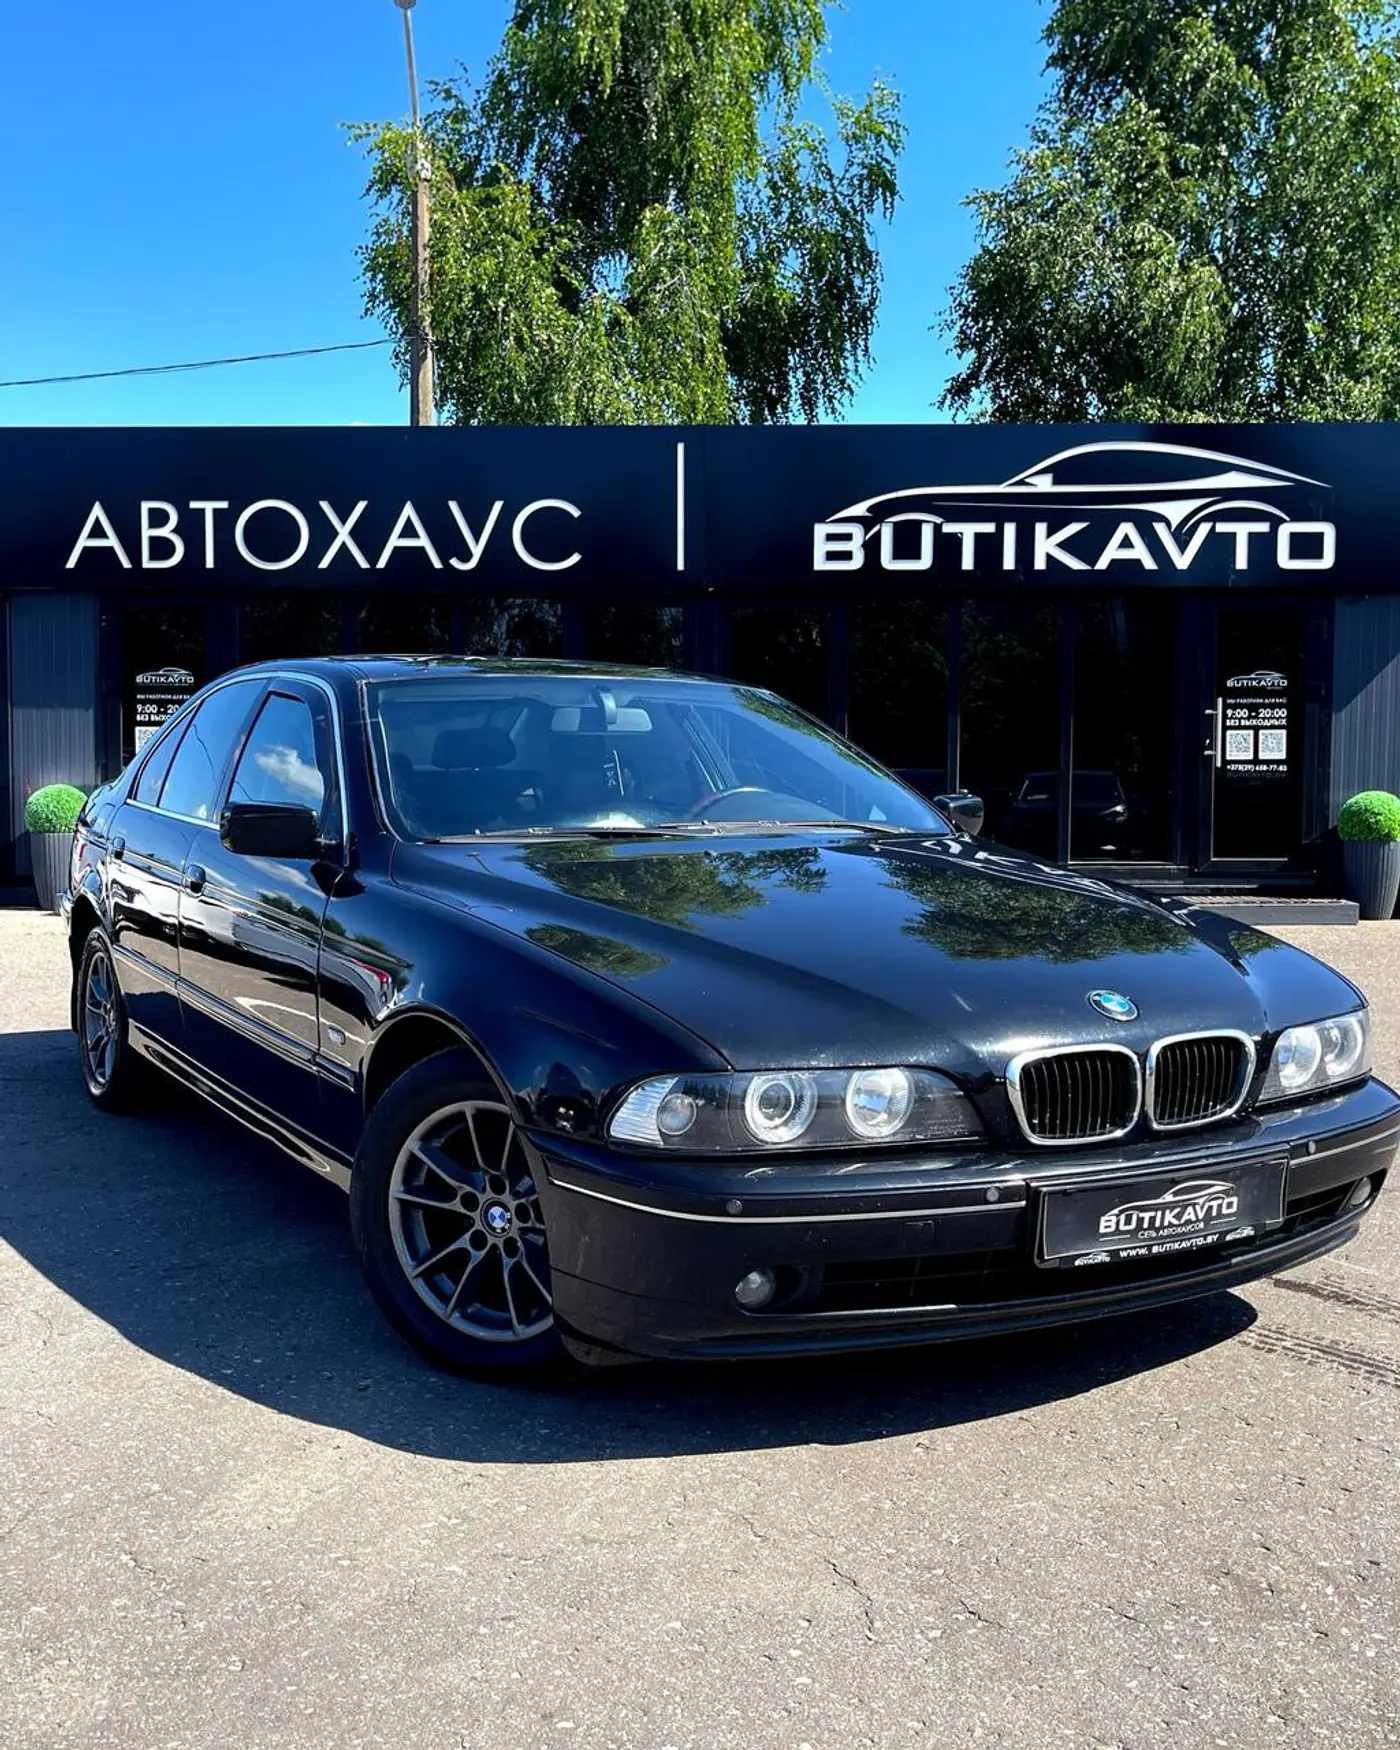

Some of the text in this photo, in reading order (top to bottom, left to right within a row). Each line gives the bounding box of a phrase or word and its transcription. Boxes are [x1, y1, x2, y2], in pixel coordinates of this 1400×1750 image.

[66, 498, 582, 571] АВТОХАУС
[813, 521, 1337, 571] BUTIKAVTO
[1227, 680, 1288, 688] BUTIKAVTO
[136, 704, 158, 713] 9:00
[1226, 708, 1248, 718] 9:00
[1258, 708, 1287, 718] 20:00
[1099, 1196, 1239, 1234] BUTIKAVTO
[1151, 1233, 1220, 1253] BUTIKAVTO.BY
